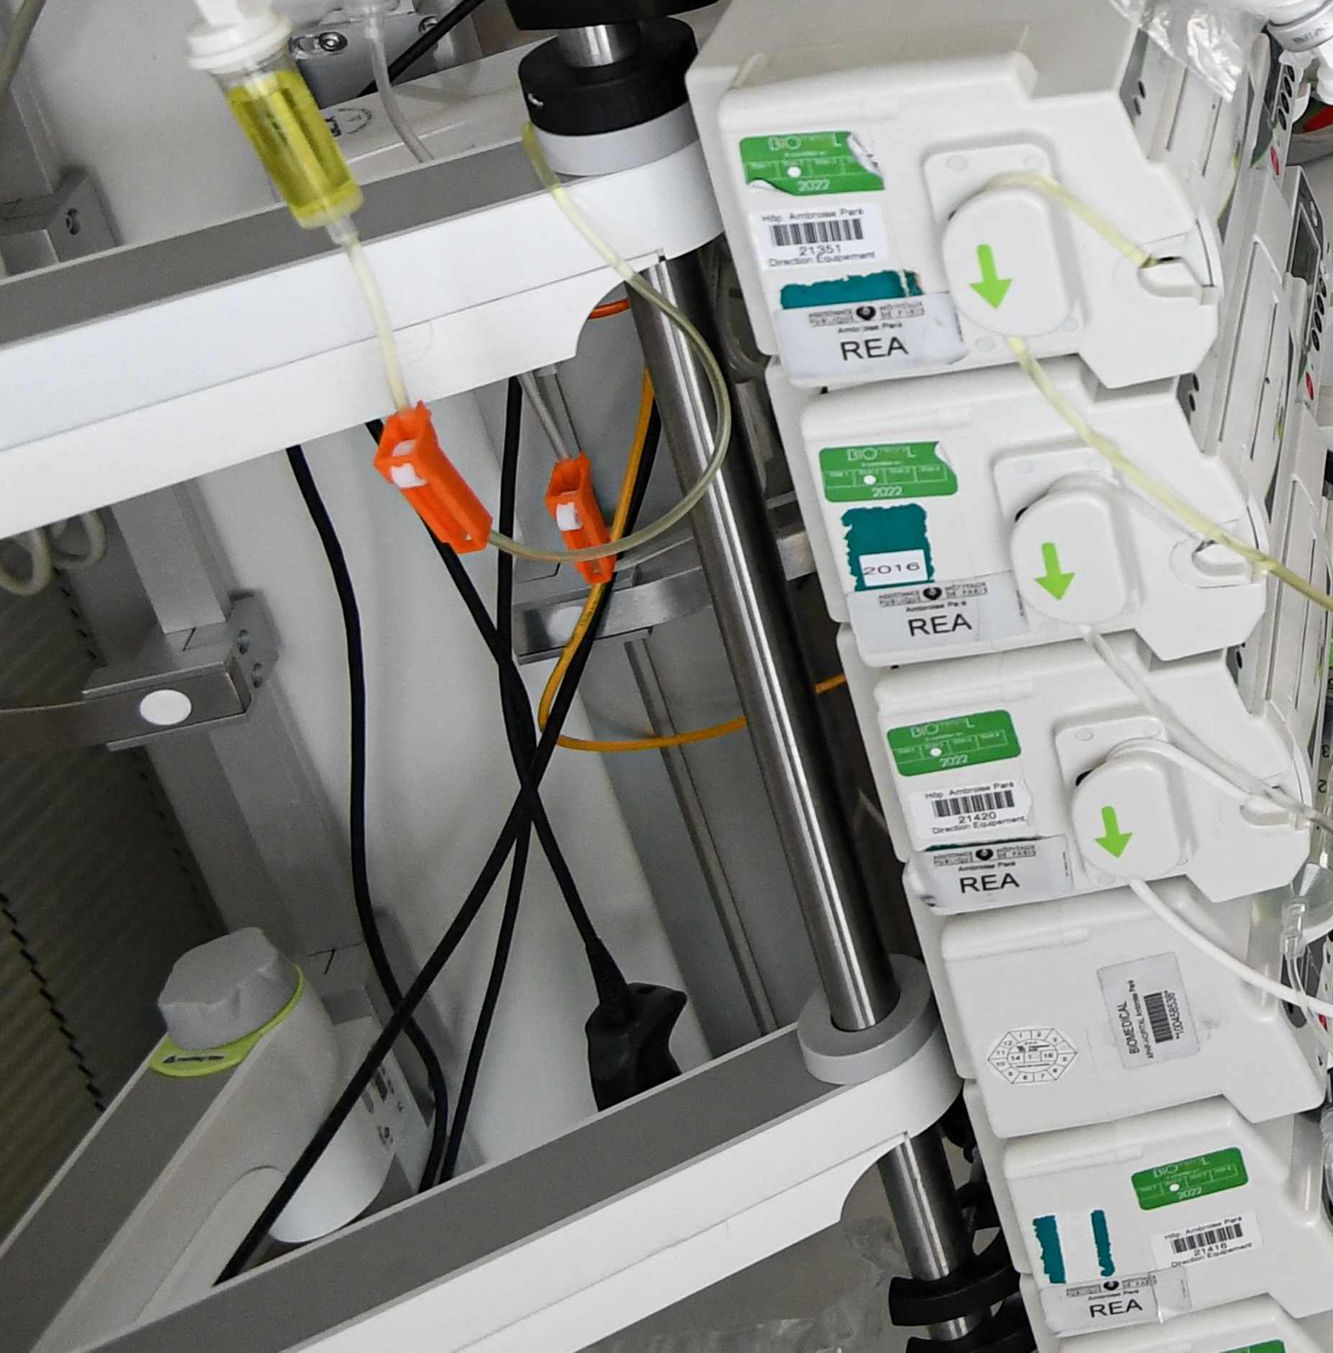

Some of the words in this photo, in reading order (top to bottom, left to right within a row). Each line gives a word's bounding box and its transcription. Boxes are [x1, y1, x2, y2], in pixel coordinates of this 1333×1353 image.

[799, 244, 842, 257] 21351
[840, 336, 909, 361] REA
[863, 561, 921, 576] 2016
[908, 613, 973, 637] REA
[958, 811, 997, 824] 21420
[932, 824, 971, 835] Direction
[959, 872, 1020, 894] REA
[1116, 999, 1141, 1055] BIOMEDICAL
[1089, 1298, 1143, 1318] REA
